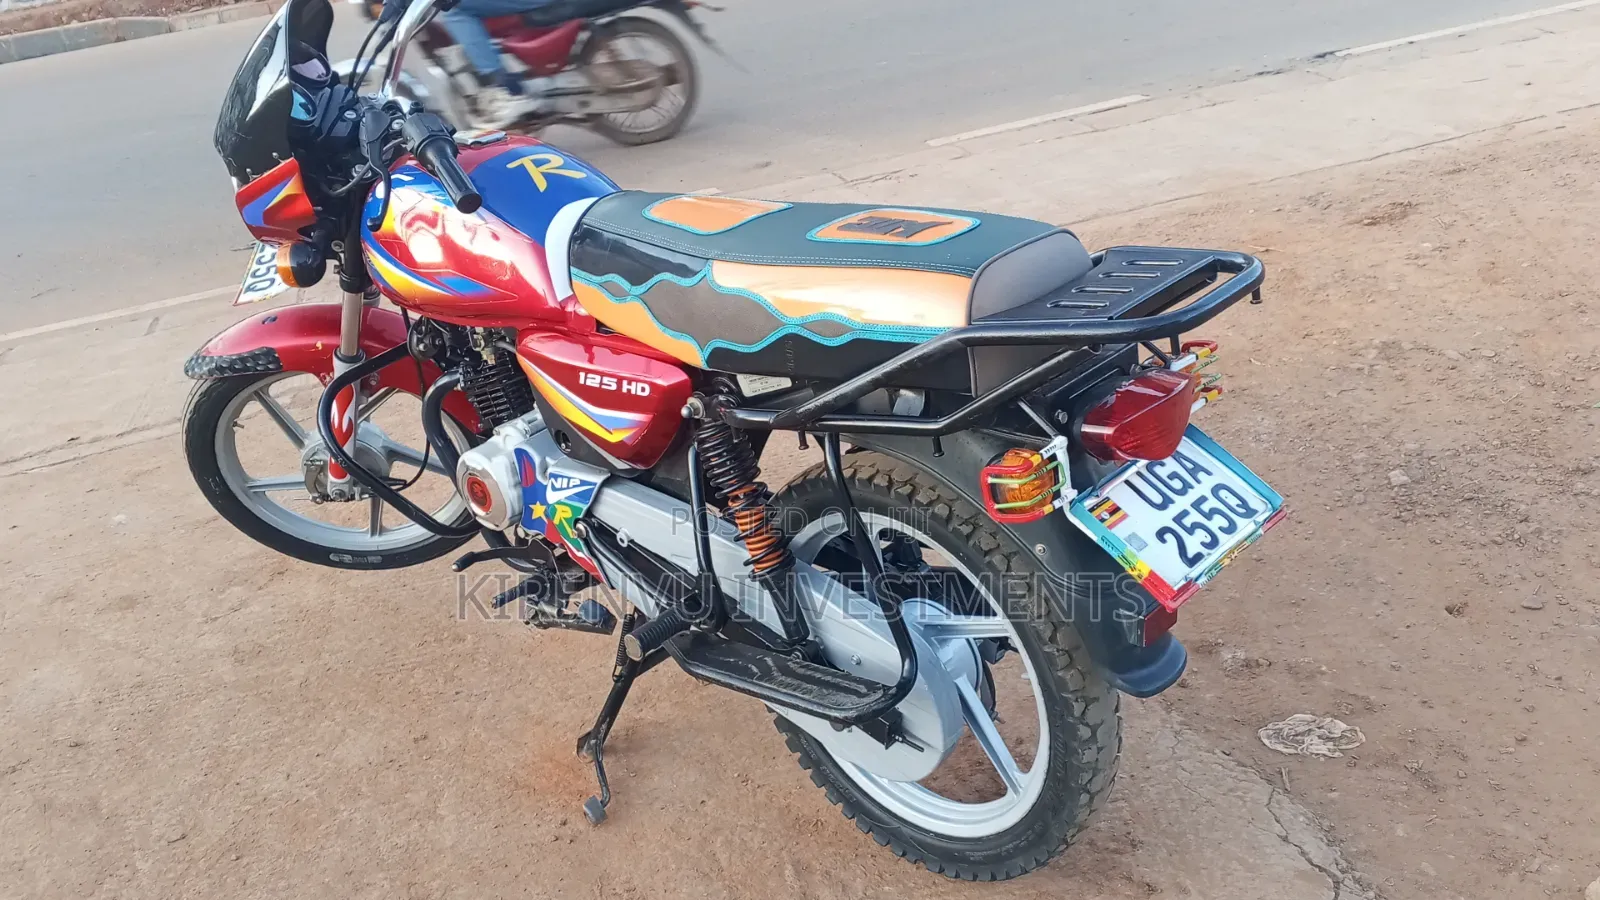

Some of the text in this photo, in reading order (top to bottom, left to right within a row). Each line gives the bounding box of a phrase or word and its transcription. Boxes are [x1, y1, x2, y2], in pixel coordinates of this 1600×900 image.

[243, 242, 278, 295] 55Q
[578, 371, 651, 397] 125 HD
[1123, 450, 1214, 512] UGA
[1155, 482, 1259, 568] 255Q
